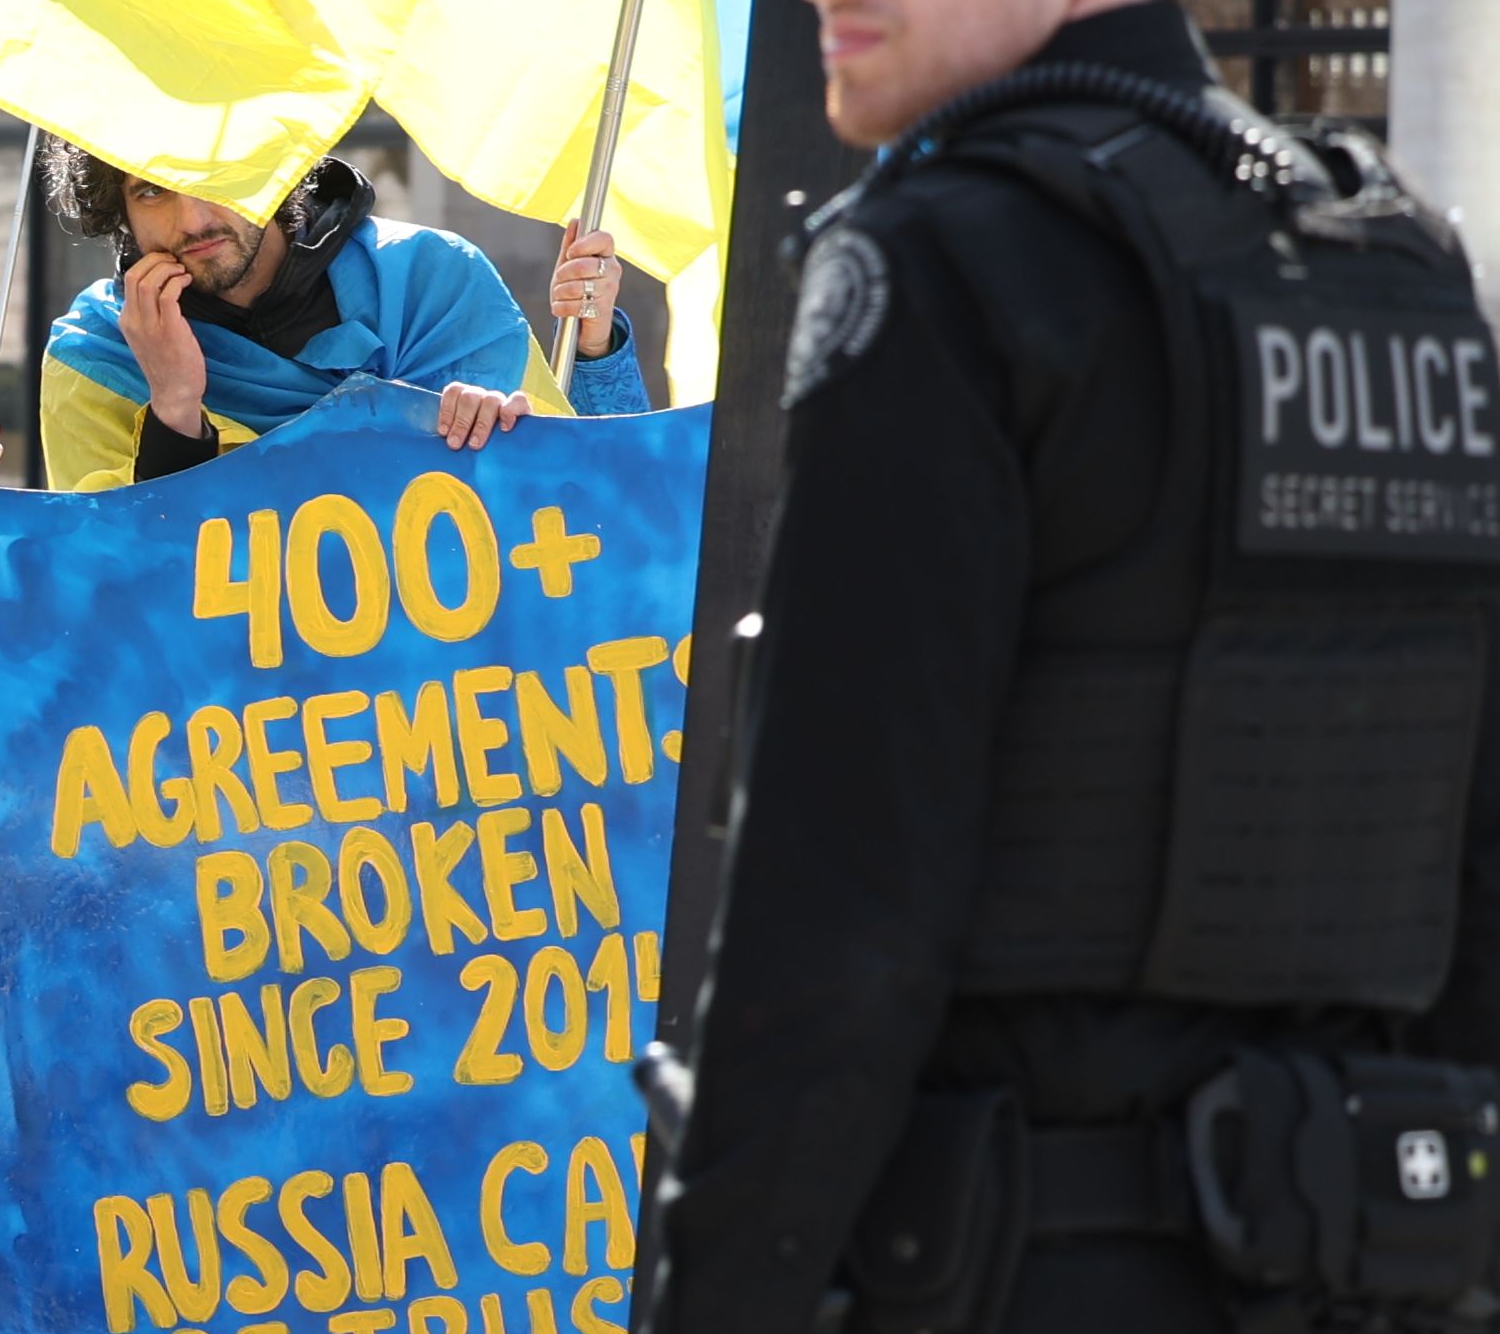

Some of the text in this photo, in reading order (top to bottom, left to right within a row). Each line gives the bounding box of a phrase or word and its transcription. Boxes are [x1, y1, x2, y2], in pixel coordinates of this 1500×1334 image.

[1256, 326, 1495, 457] POLICE
[192, 470, 602, 670] 400+
[1260, 472, 1377, 531] SECRET
[195, 802, 621, 983] BROKEN
[126, 965, 415, 1123] SINCE
[479, 1131, 648, 1278] CA
